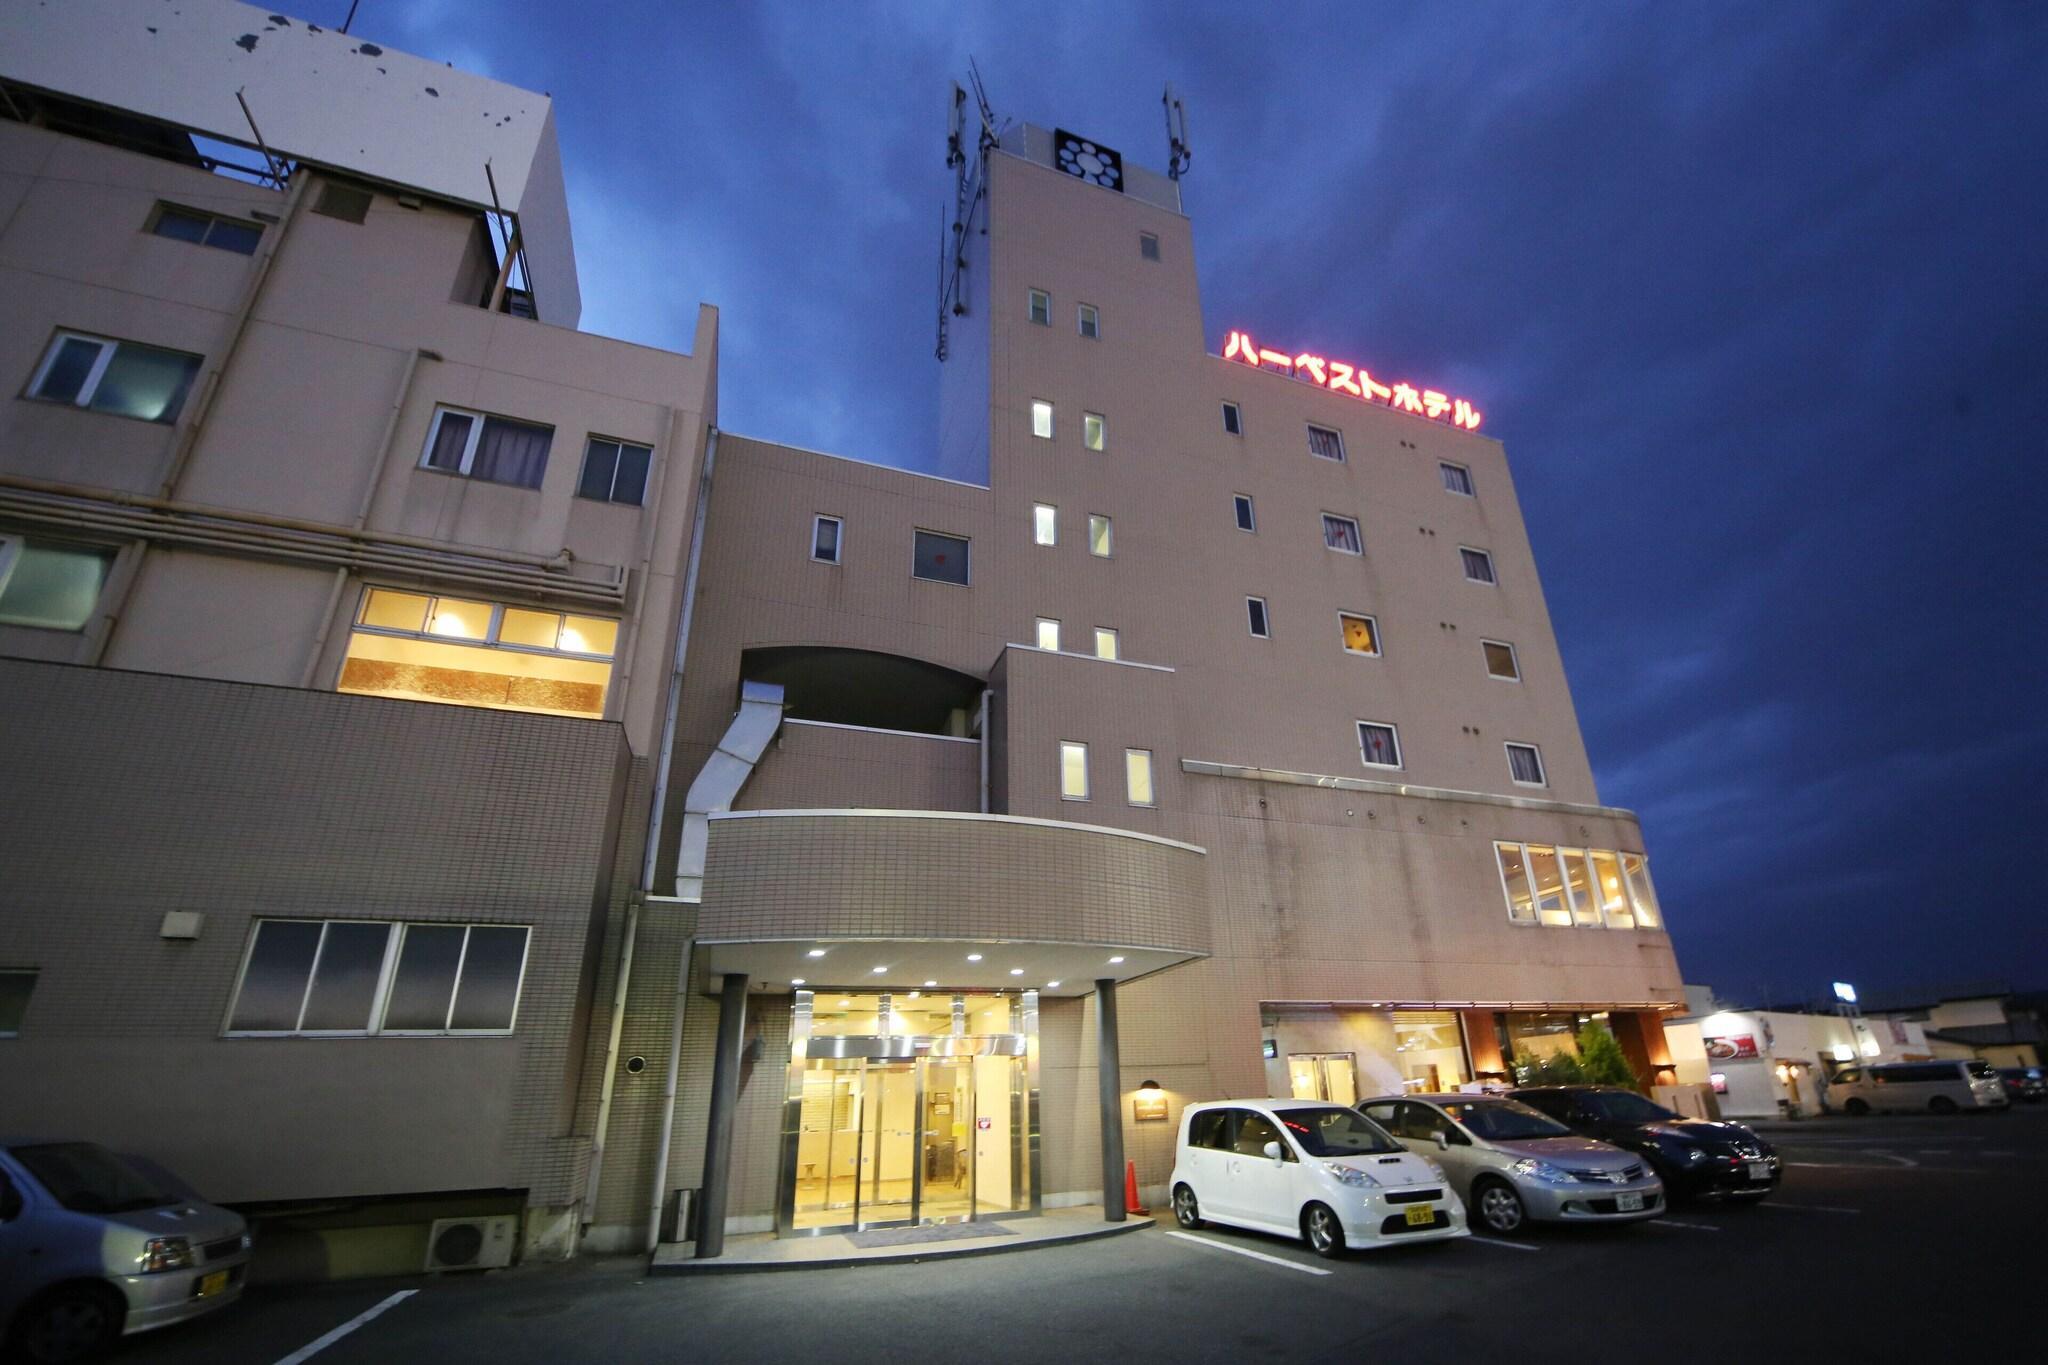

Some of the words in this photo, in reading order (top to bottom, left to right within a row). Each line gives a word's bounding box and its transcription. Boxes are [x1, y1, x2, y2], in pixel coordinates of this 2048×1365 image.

[1224, 331, 1481, 429] ハーベストホテル
